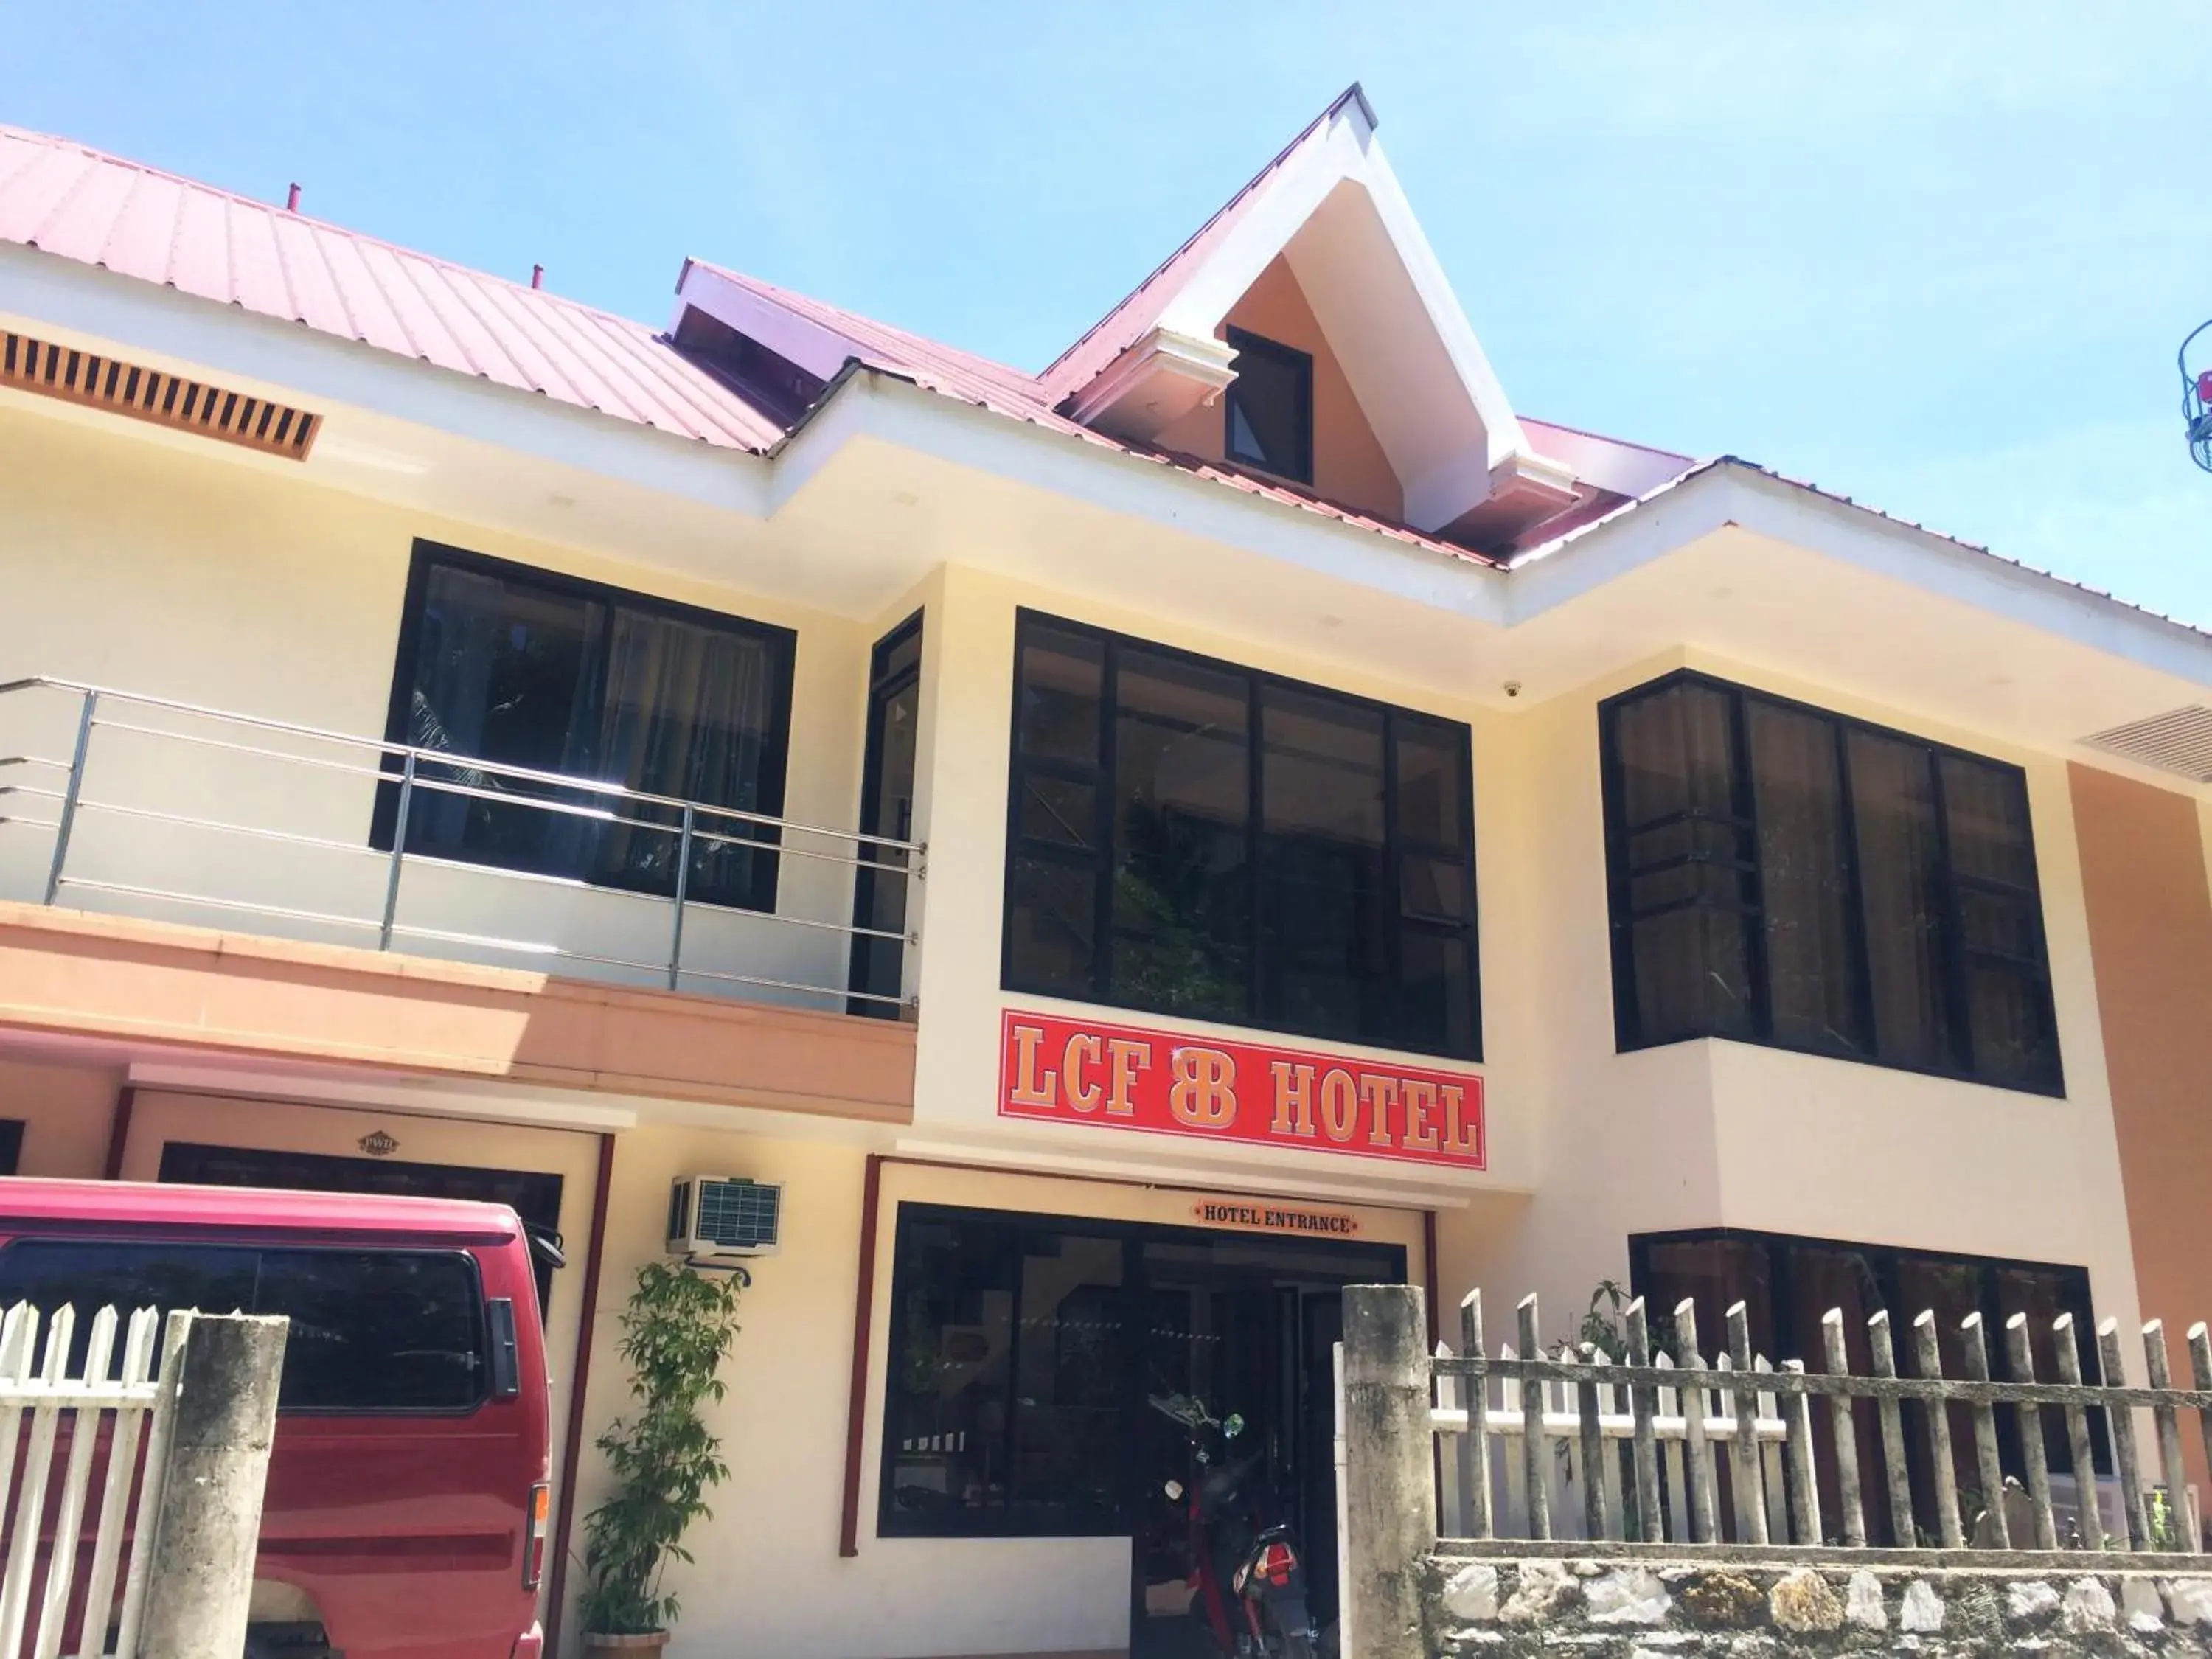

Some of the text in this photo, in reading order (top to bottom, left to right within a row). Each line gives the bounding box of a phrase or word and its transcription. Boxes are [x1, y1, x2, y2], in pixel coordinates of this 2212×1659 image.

[1011, 1026, 1151, 1116] LCF
[1270, 1060, 1479, 1156] HOTEL
[1204, 1206, 1350, 1233] HOTEL ENTRANCE
